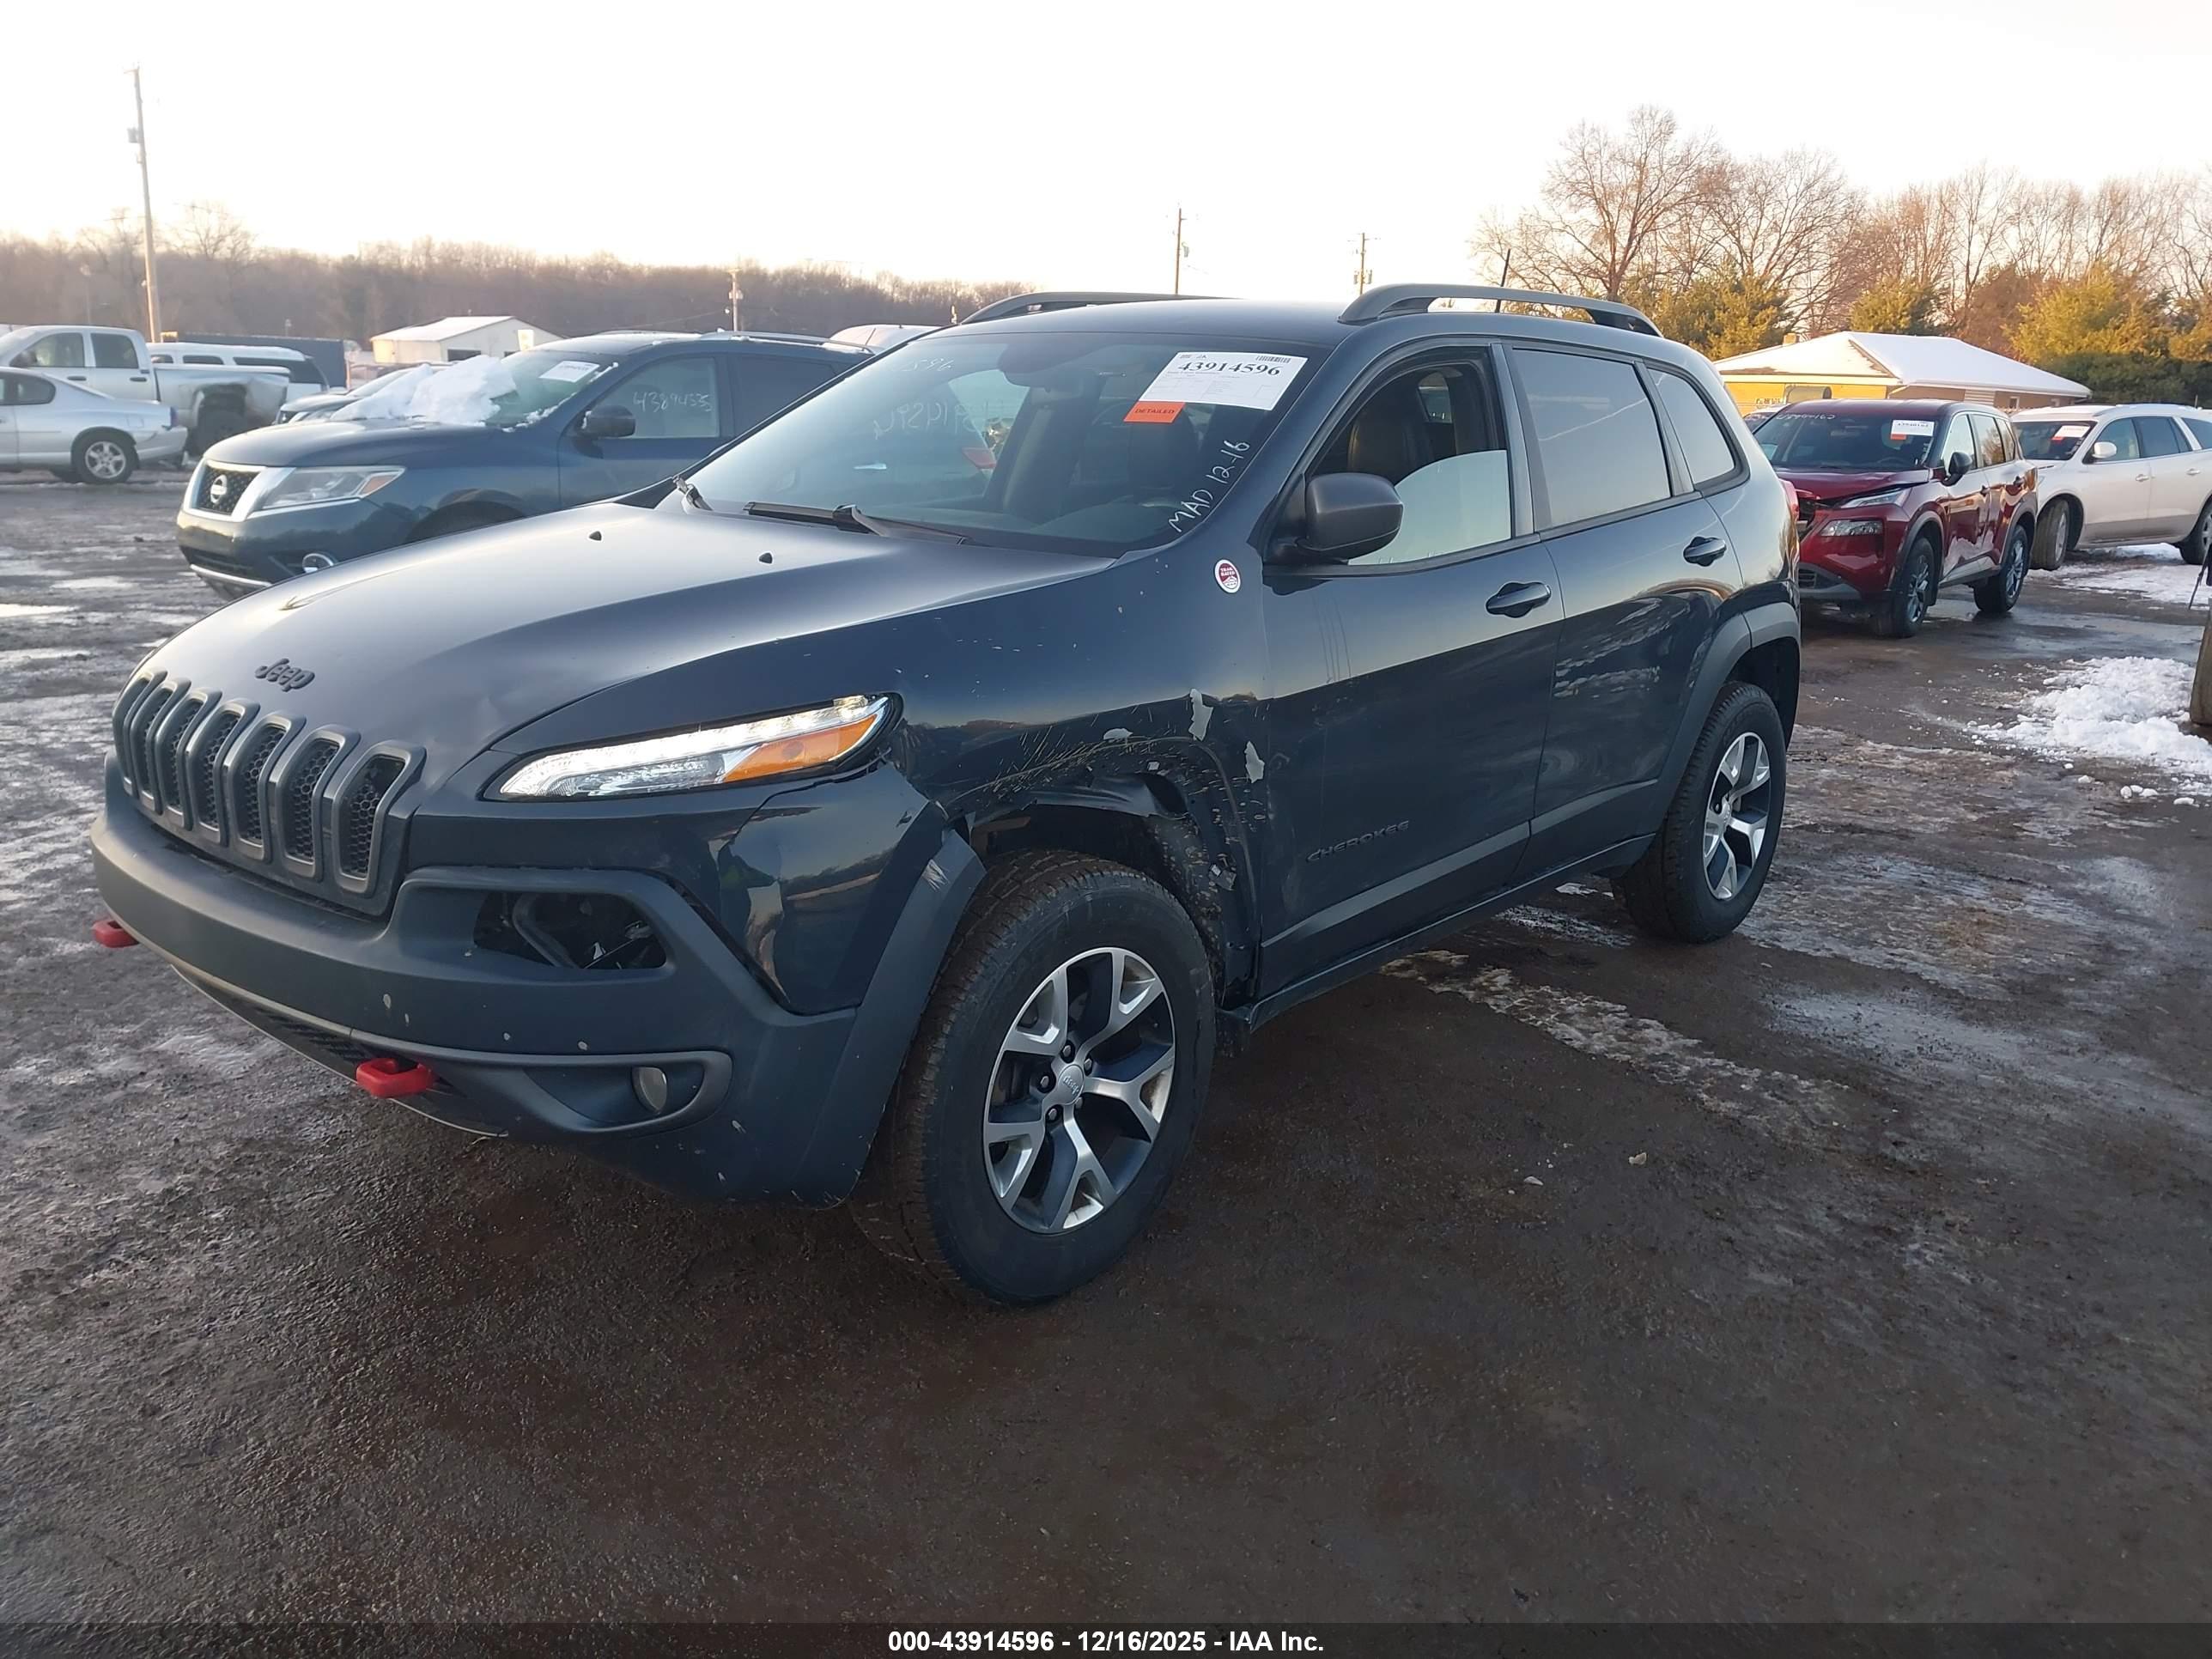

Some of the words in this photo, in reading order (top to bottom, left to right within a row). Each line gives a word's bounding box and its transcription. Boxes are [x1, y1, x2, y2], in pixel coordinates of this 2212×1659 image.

[1177, 362, 1285, 376] 43914596
[1168, 489, 1213, 533] MAD
[1205, 440, 1250, 484] 12-16
[254, 658, 315, 693] Jeep
[1306, 820, 1409, 861] CHEROKEE
